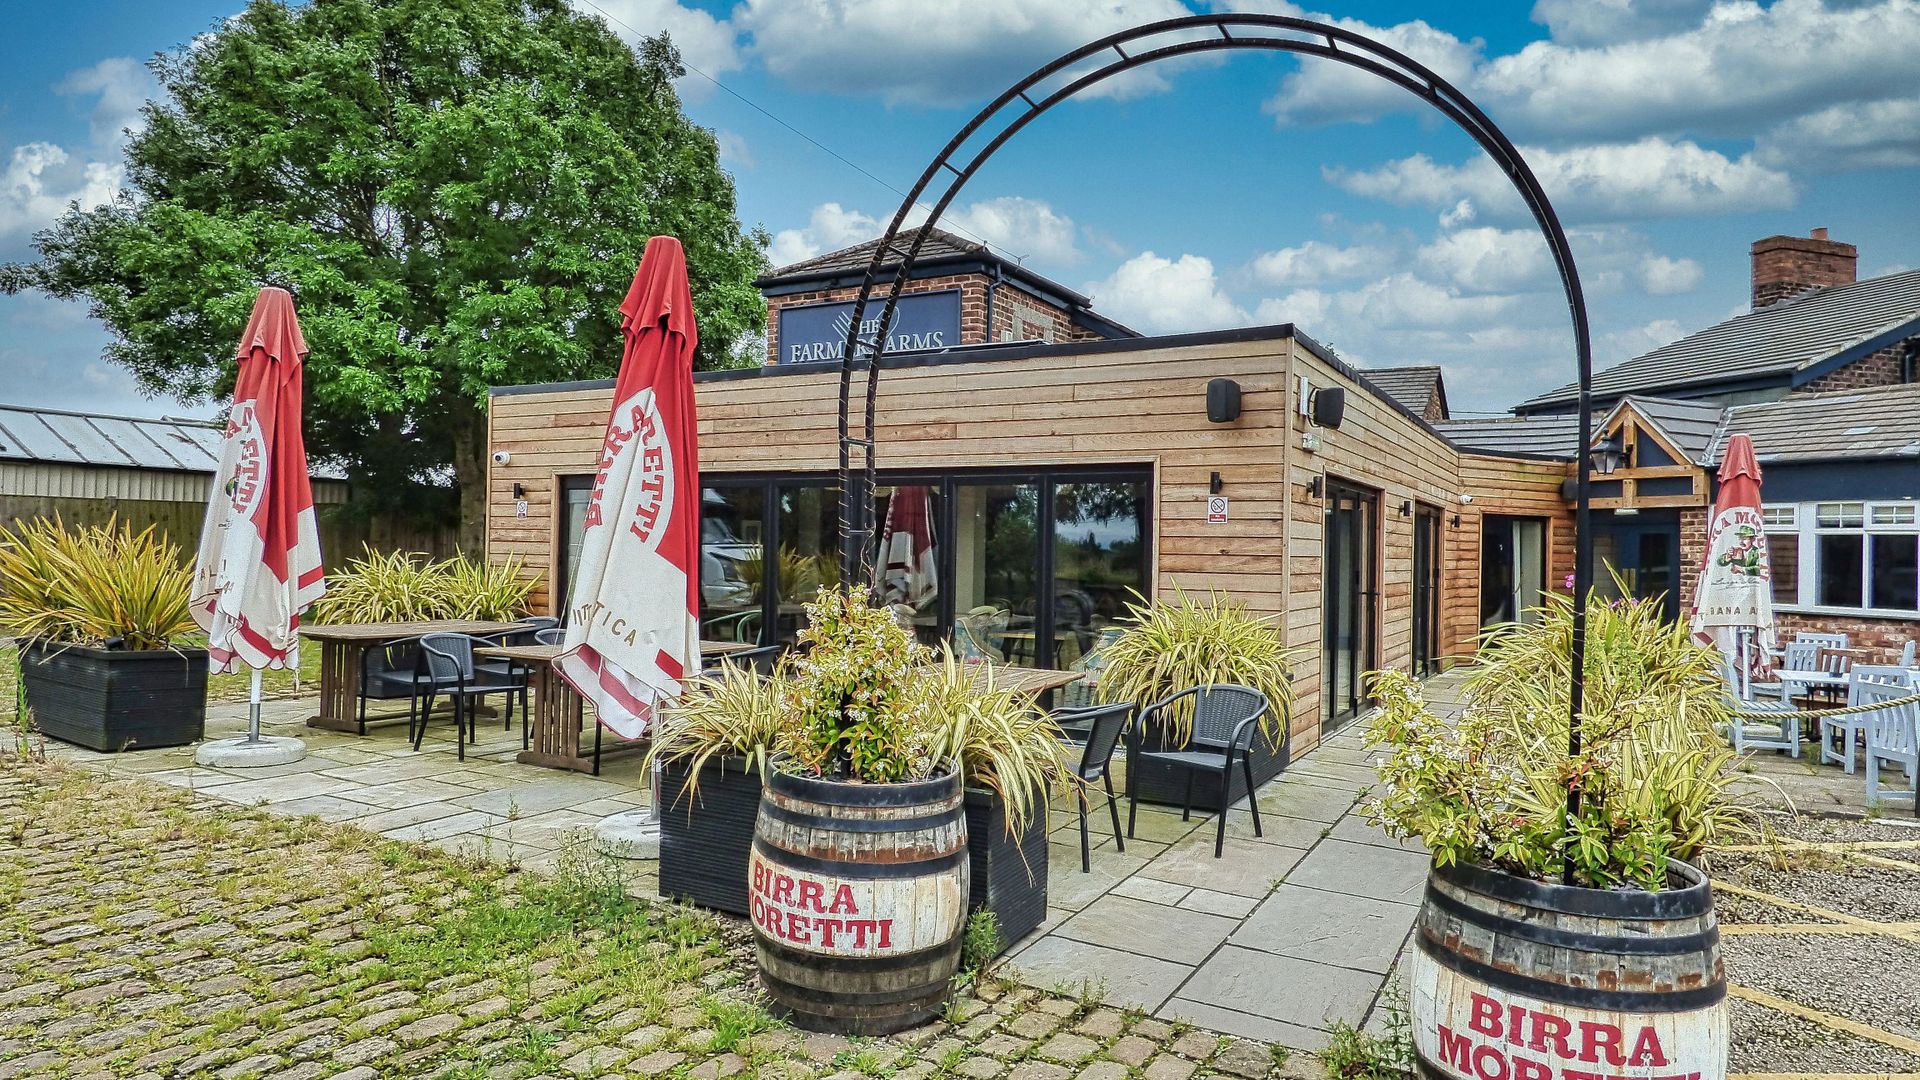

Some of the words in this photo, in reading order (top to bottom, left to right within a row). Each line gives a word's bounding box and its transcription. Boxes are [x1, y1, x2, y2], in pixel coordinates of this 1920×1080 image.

[790, 338, 880, 363] FARMRS
[884, 331, 943, 352] ARMS
[849, 319, 880, 335] HE
[753, 860, 859, 915] BIRRA
[749, 891, 893, 949] ORETTI
[1468, 991, 1670, 1067] BIRRA
